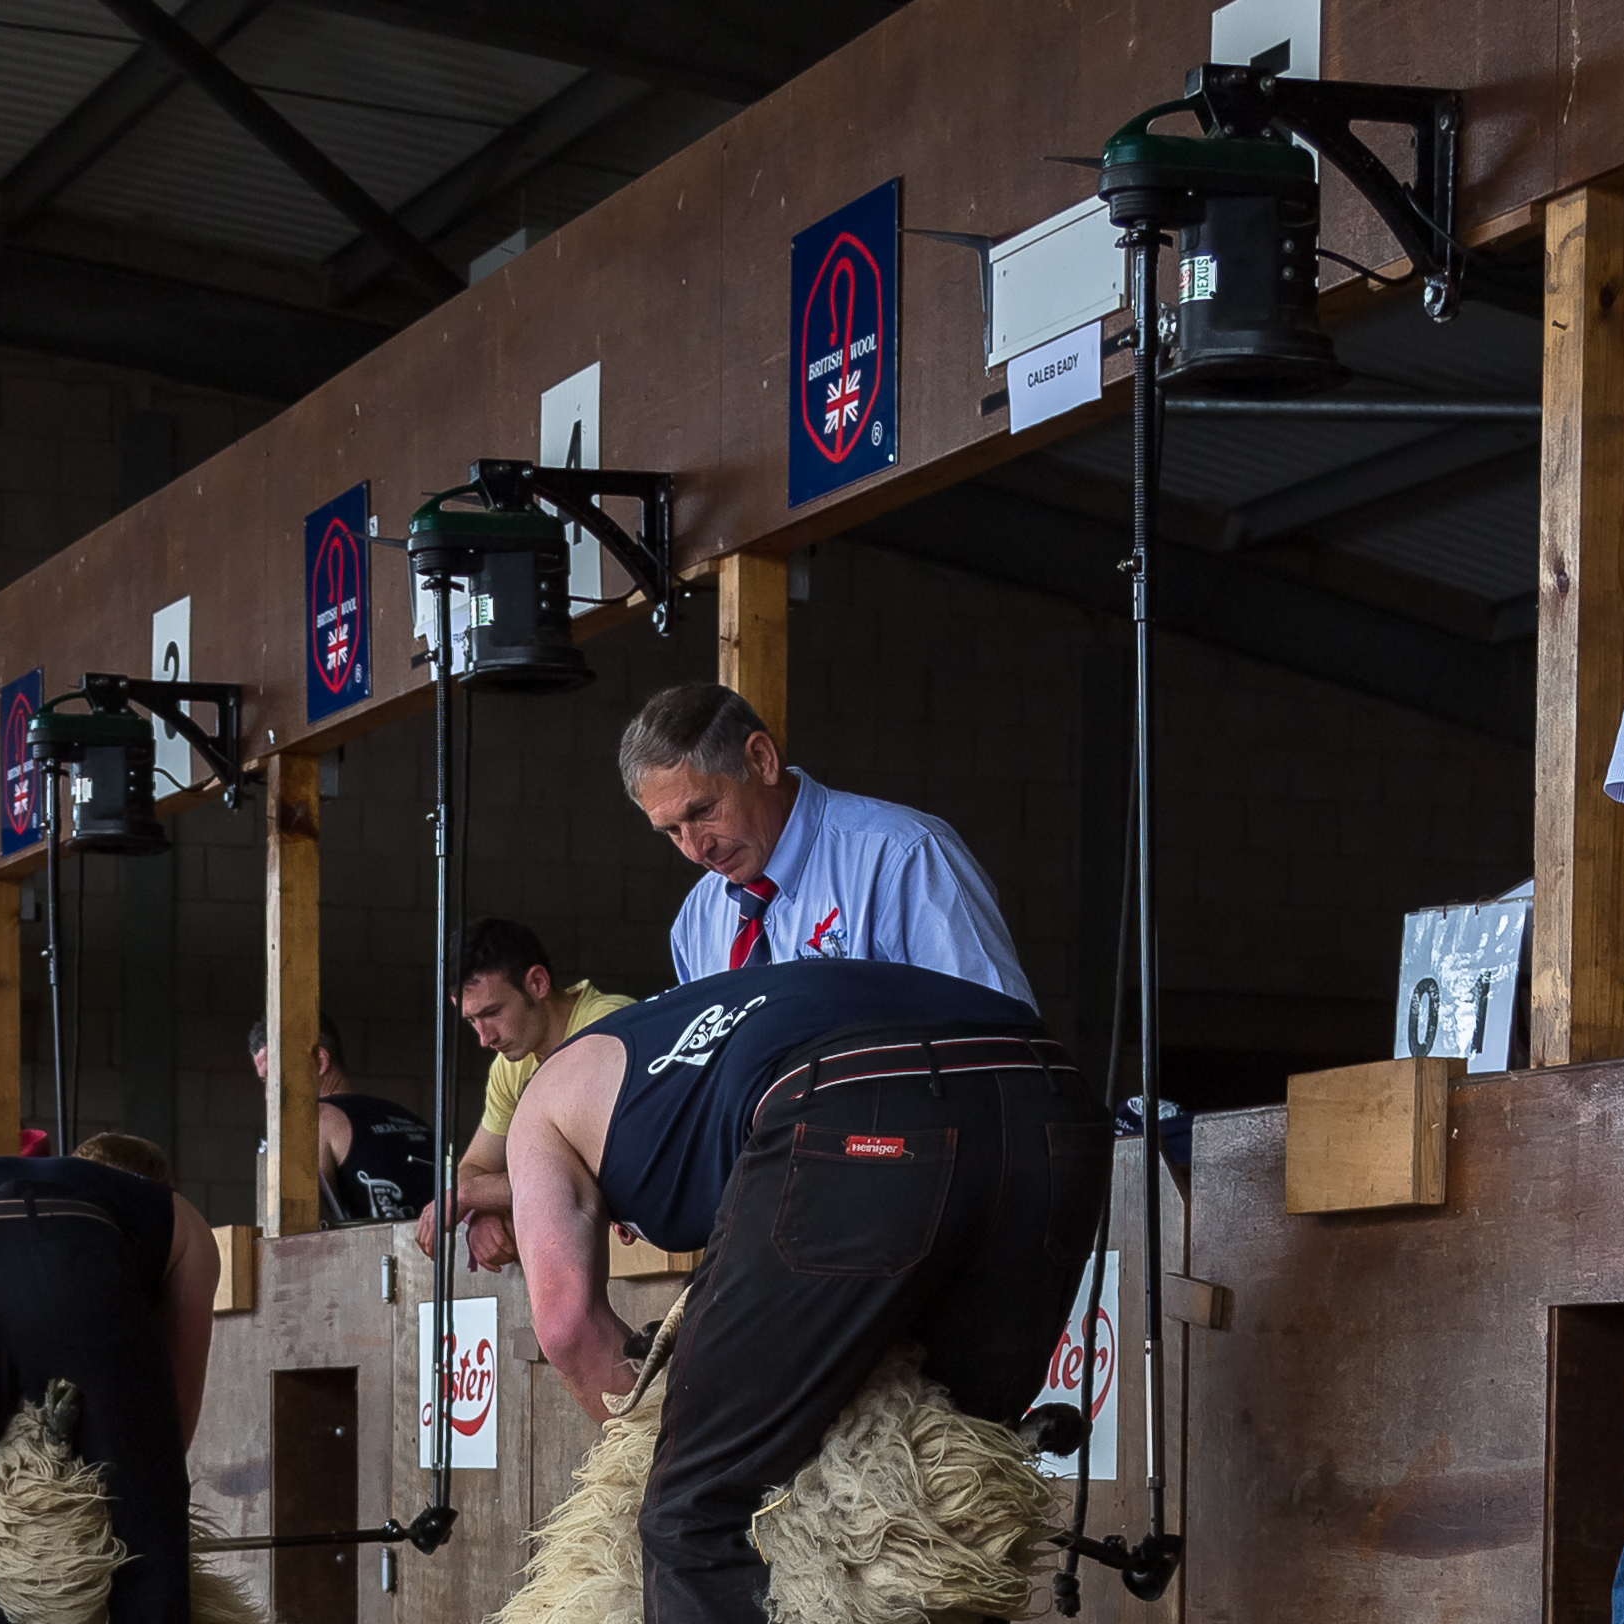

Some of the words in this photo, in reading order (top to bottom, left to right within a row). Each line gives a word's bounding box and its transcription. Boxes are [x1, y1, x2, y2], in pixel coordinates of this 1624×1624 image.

[1196, 258, 1209, 297] NEXUS
[808, 349, 843, 381] BRITISH
[850, 333, 877, 361] WOOL
[1027, 364, 1056, 388] CALEB
[1057, 353, 1080, 376] EADY
[851, 1138, 899, 1155] Heiniger
